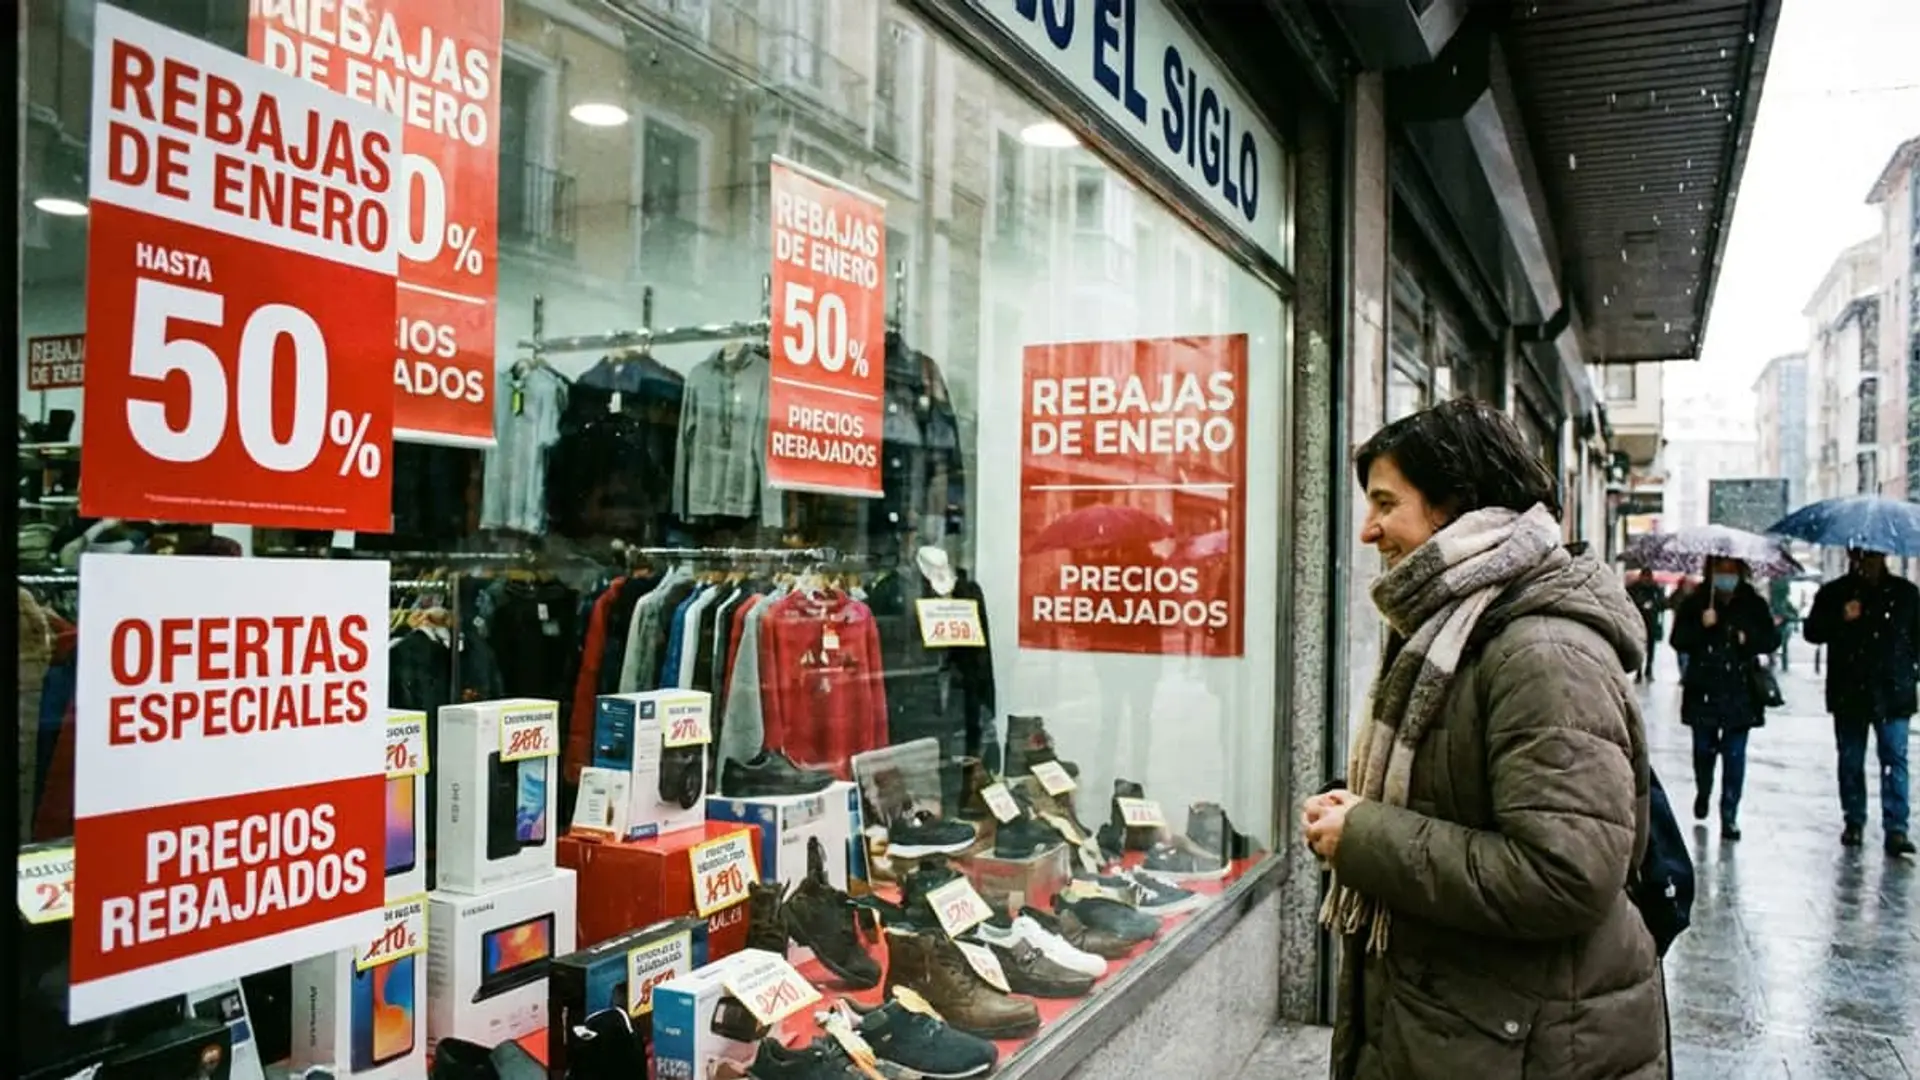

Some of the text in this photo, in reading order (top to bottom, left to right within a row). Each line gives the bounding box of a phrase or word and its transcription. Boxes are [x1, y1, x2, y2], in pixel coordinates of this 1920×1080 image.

[110, 38, 391, 194] REBAJAS
[264, 26, 488, 147] DE ENERO
[1094, 0, 1258, 223] EL SIGLO
[108, 121, 389, 254] DE ENERO
[398, 152, 483, 275] 0%
[776, 189, 879, 258] REBAJAS
[136, 241, 213, 283] HASTA
[777, 233, 878, 290] DE ENERO
[32, 338, 85, 363] REBAJ
[782, 280, 869, 379] 50%
[126, 276, 382, 479] 50%
[1032, 370, 1236, 417] REBAJAS
[771, 431, 877, 468] REBAJADOS
[787, 405, 865, 438] PRECIOS
[1031, 415, 1235, 456] DE ENERO
[1033, 596, 1228, 627] REBAJADOS
[1060, 563, 1199, 593] PRECIOS
[110, 614, 370, 687] OFERTAS
[109, 679, 369, 745] ESPECIALES
[146, 803, 336, 883] PRECIOS
[101, 848, 368, 952] REBAJADOS
